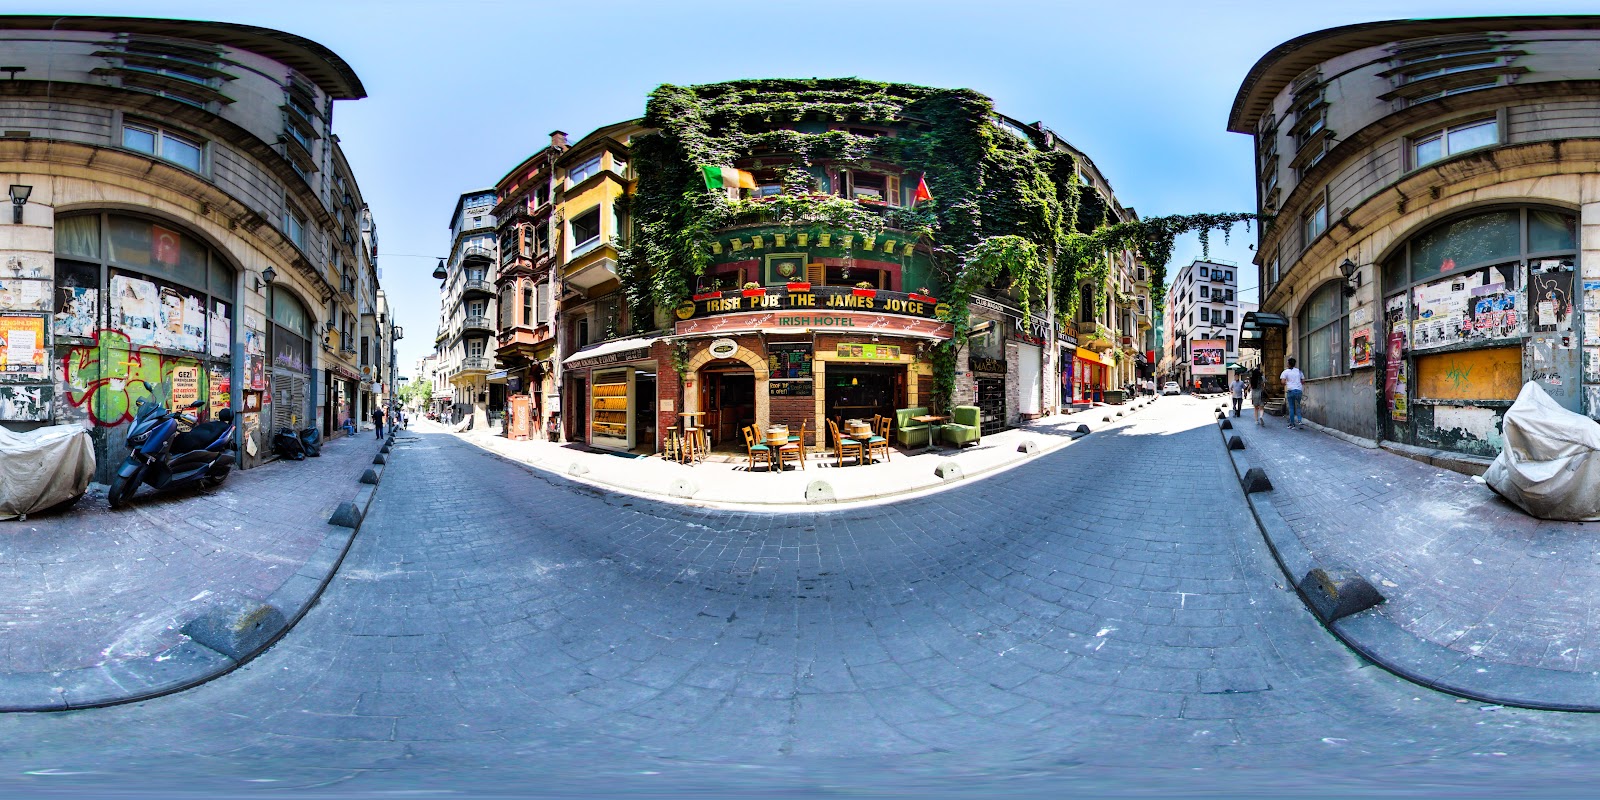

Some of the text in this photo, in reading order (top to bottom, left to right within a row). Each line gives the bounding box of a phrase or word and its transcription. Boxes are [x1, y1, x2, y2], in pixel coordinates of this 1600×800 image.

[706, 297, 742, 312] IRISH
[750, 293, 779, 308] PUB
[788, 293, 816, 306] THE
[826, 294, 874, 308] JAMES
[883, 298, 924, 314] JOYCE
[975, 298, 988, 307] CLUB
[684, 321, 698, 334] food
[779, 316, 855, 327] IRISH HOTEL
[1015, 316, 1047, 338] KYN
